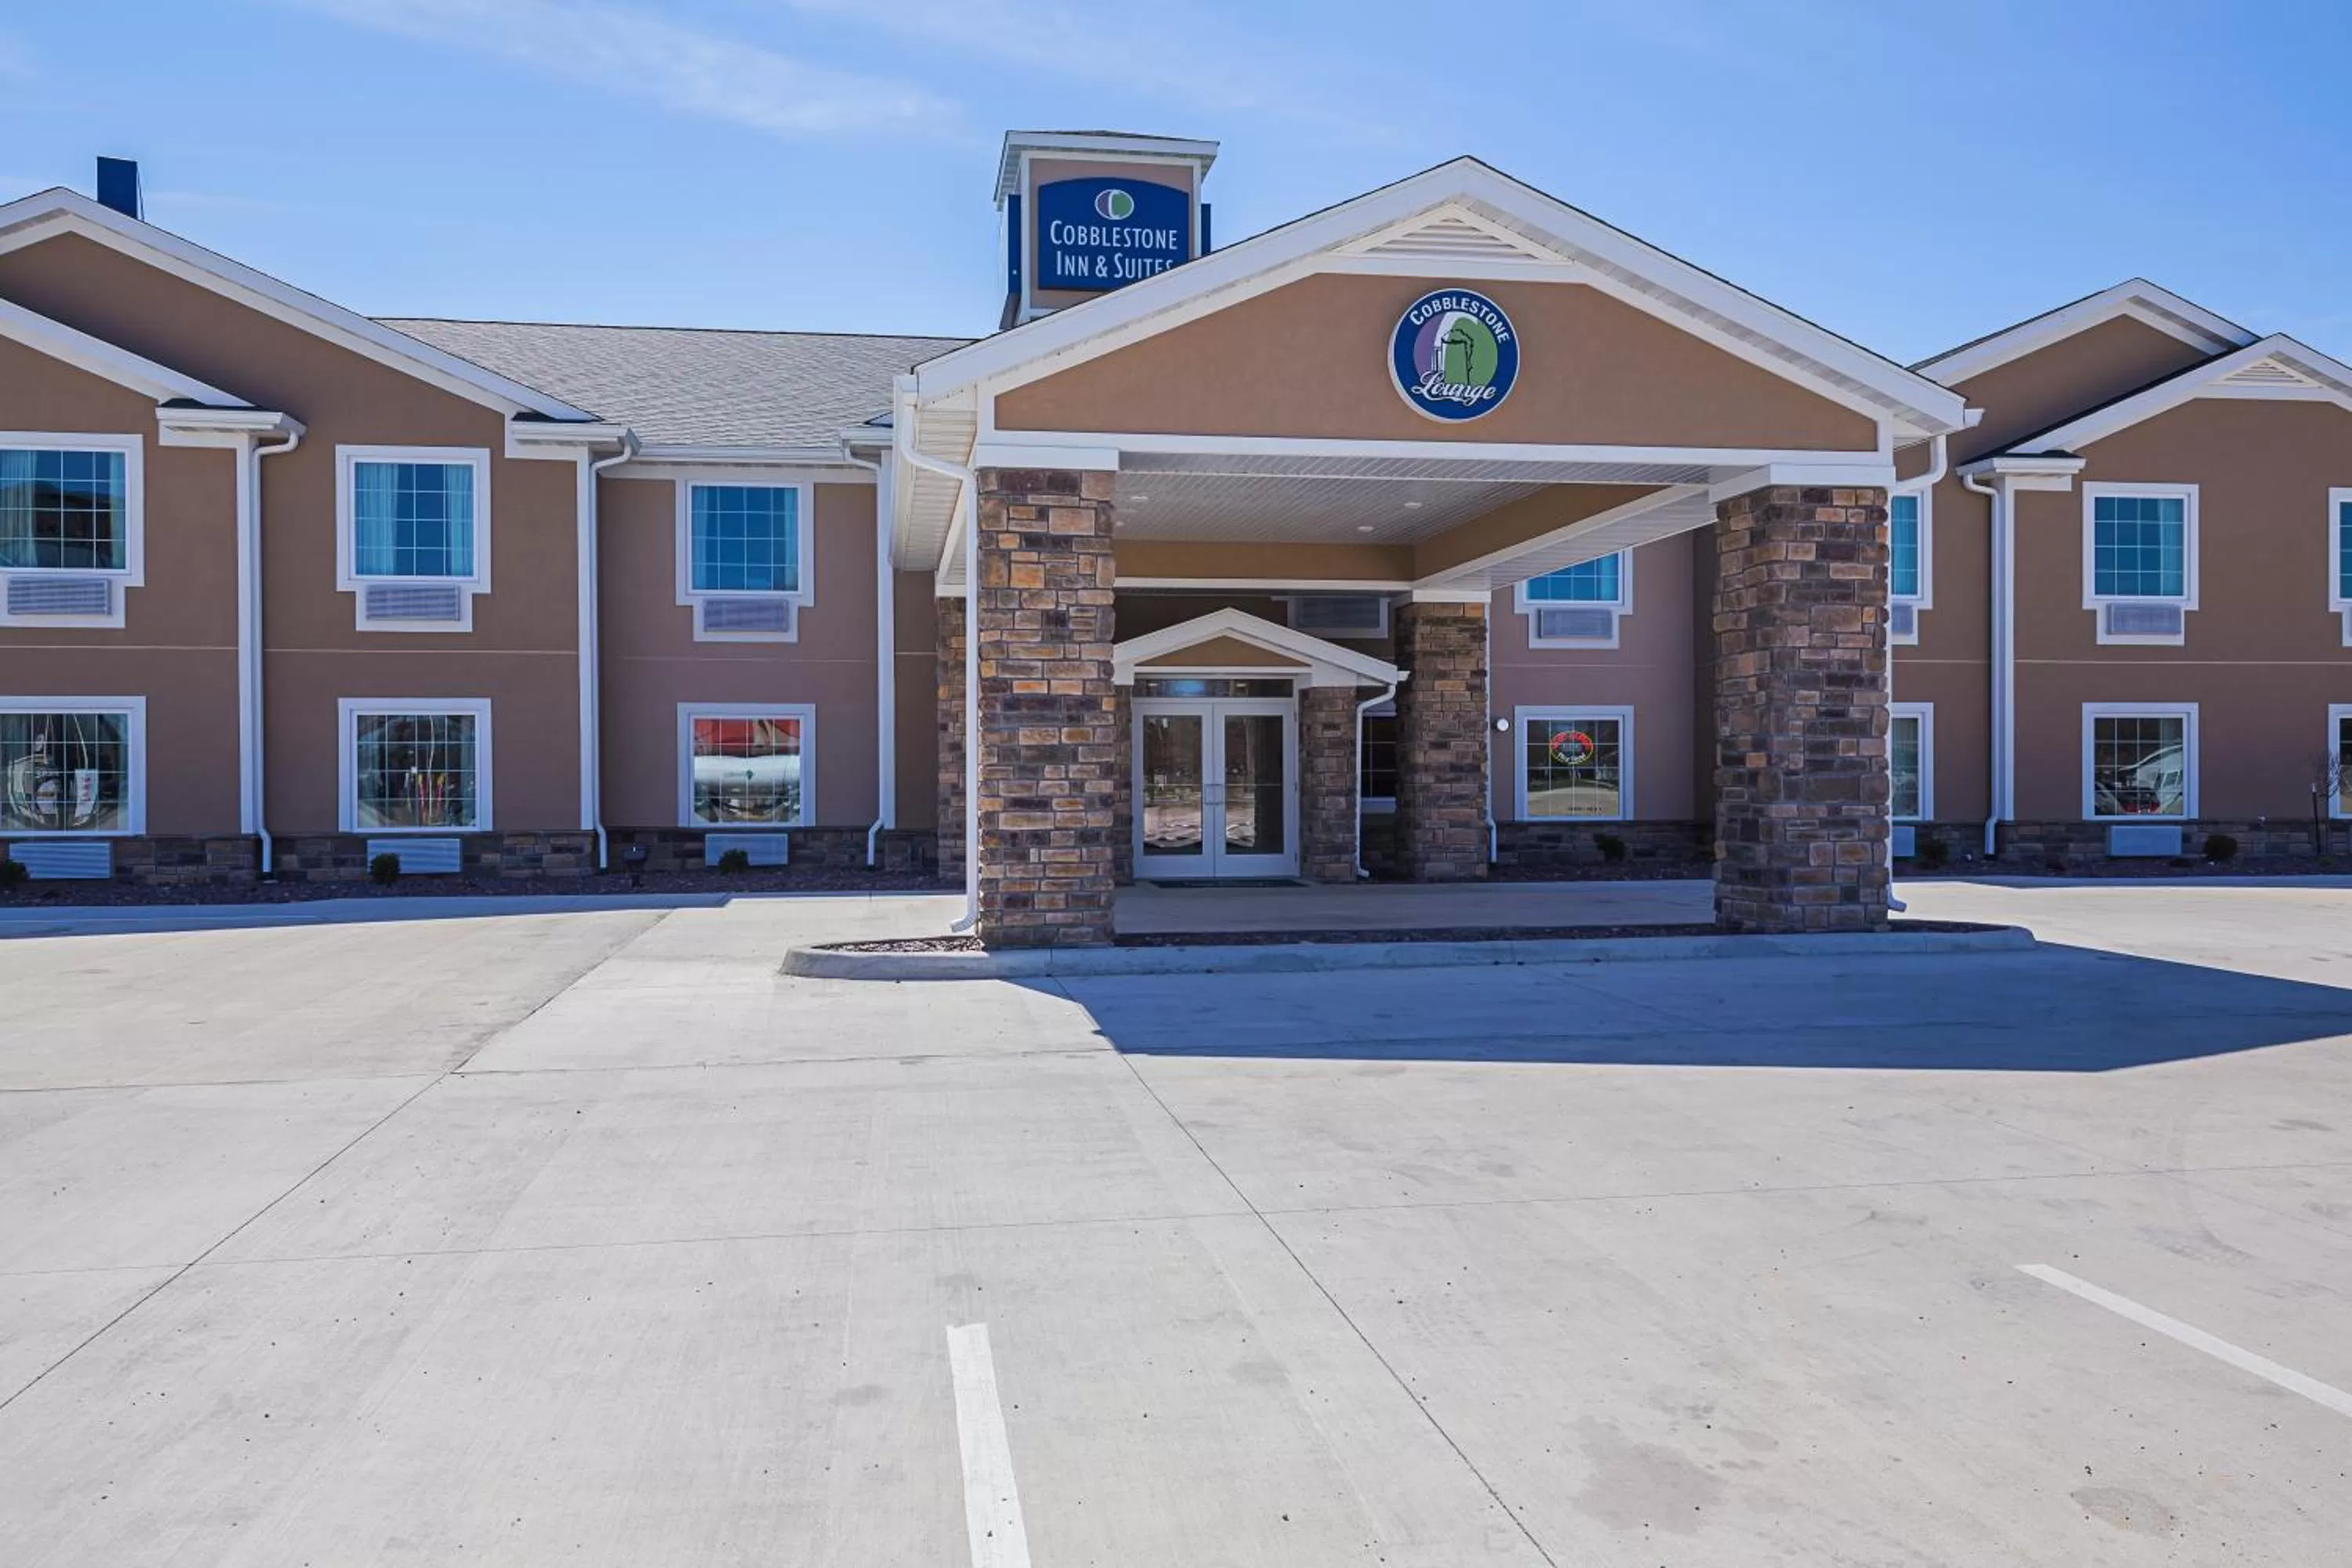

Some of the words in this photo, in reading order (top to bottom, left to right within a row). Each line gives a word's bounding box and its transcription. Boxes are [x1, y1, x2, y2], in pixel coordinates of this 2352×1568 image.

[1050, 220, 1178, 250] COBBLESTONE
[1056, 250, 1089, 277] INN
[1095, 255, 1108, 278] &
[1409, 296, 1510, 343] COBBLESTONE
[1411, 371, 1497, 407] Lounge
